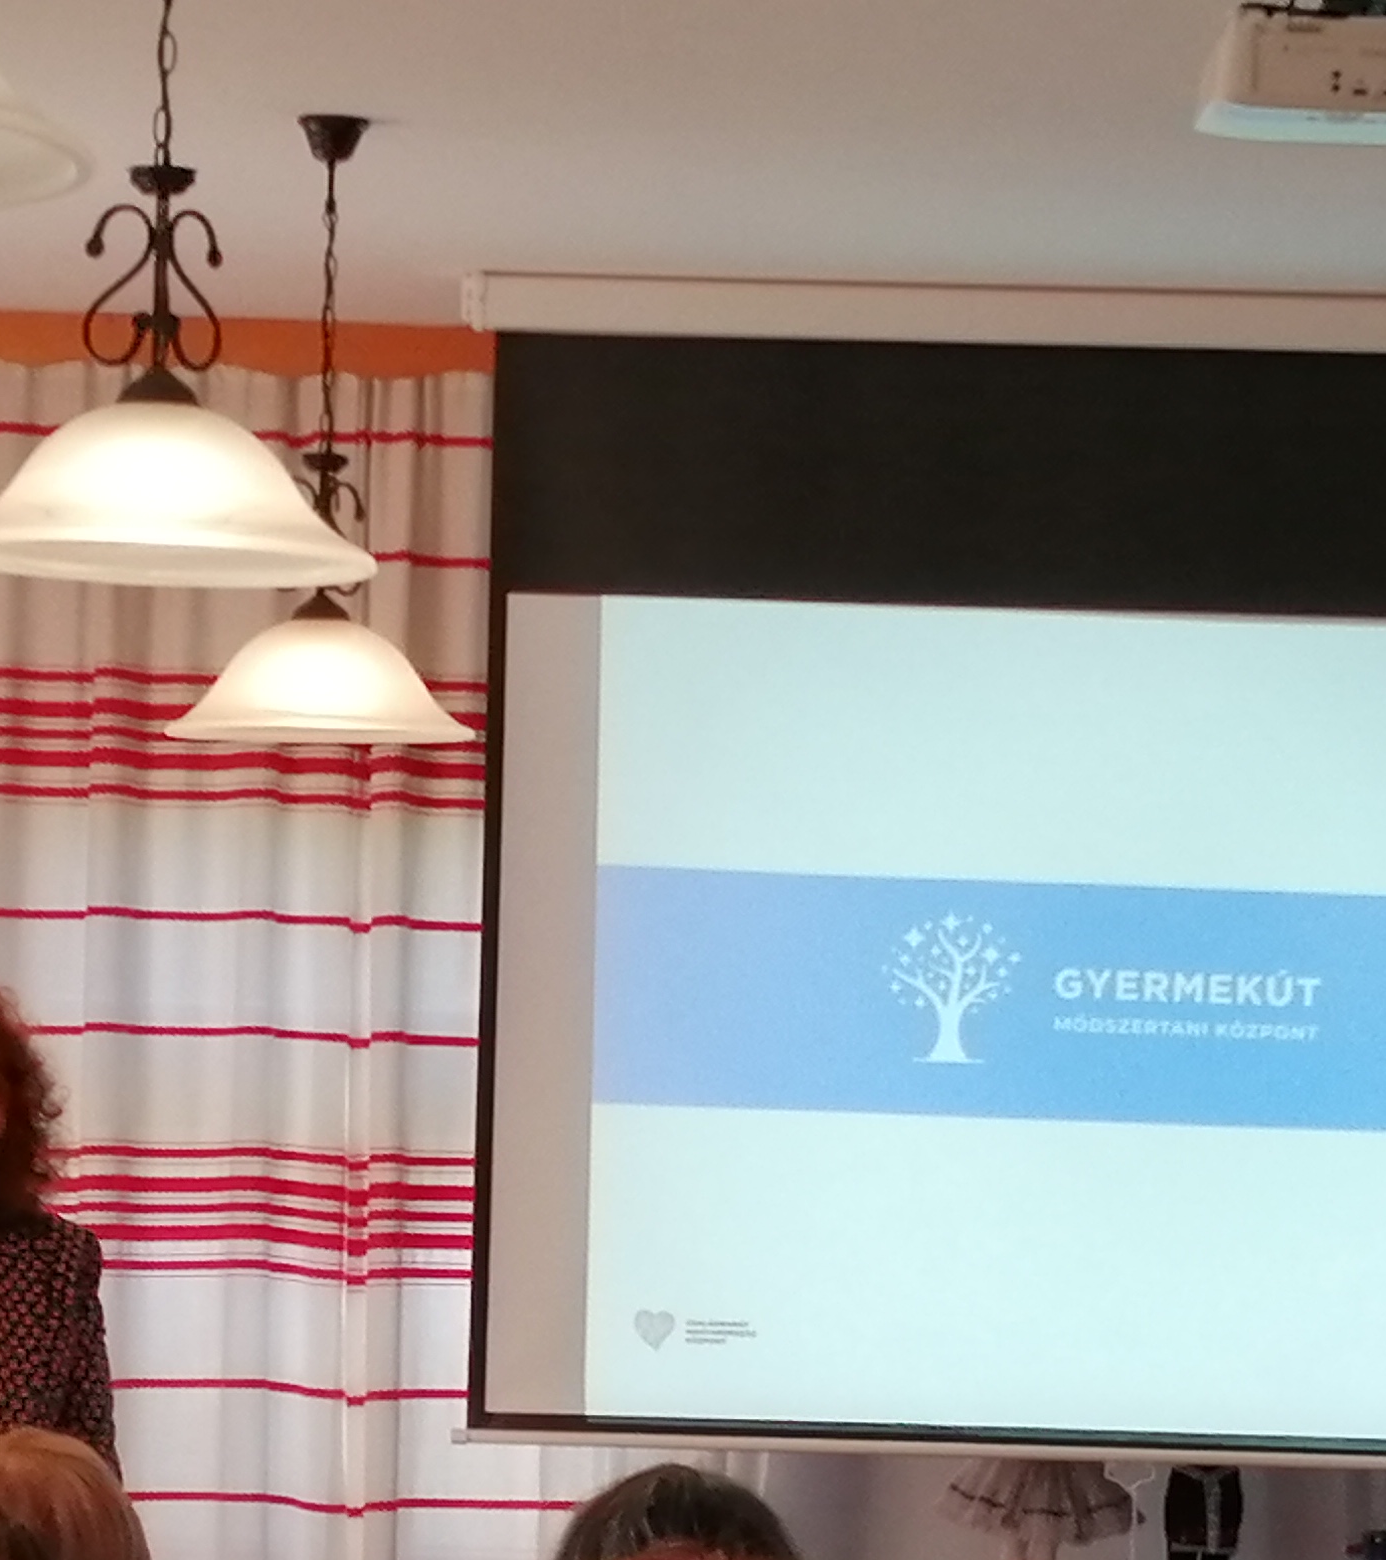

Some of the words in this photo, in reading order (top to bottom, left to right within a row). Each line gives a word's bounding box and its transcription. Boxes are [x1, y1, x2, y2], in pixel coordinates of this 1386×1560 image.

[1054, 968, 1322, 1007] GYERMEKÚT
[1053, 1014, 1210, 1037] MÓDSZERTANI
[1215, 1019, 1320, 1041] KÖZPONT
